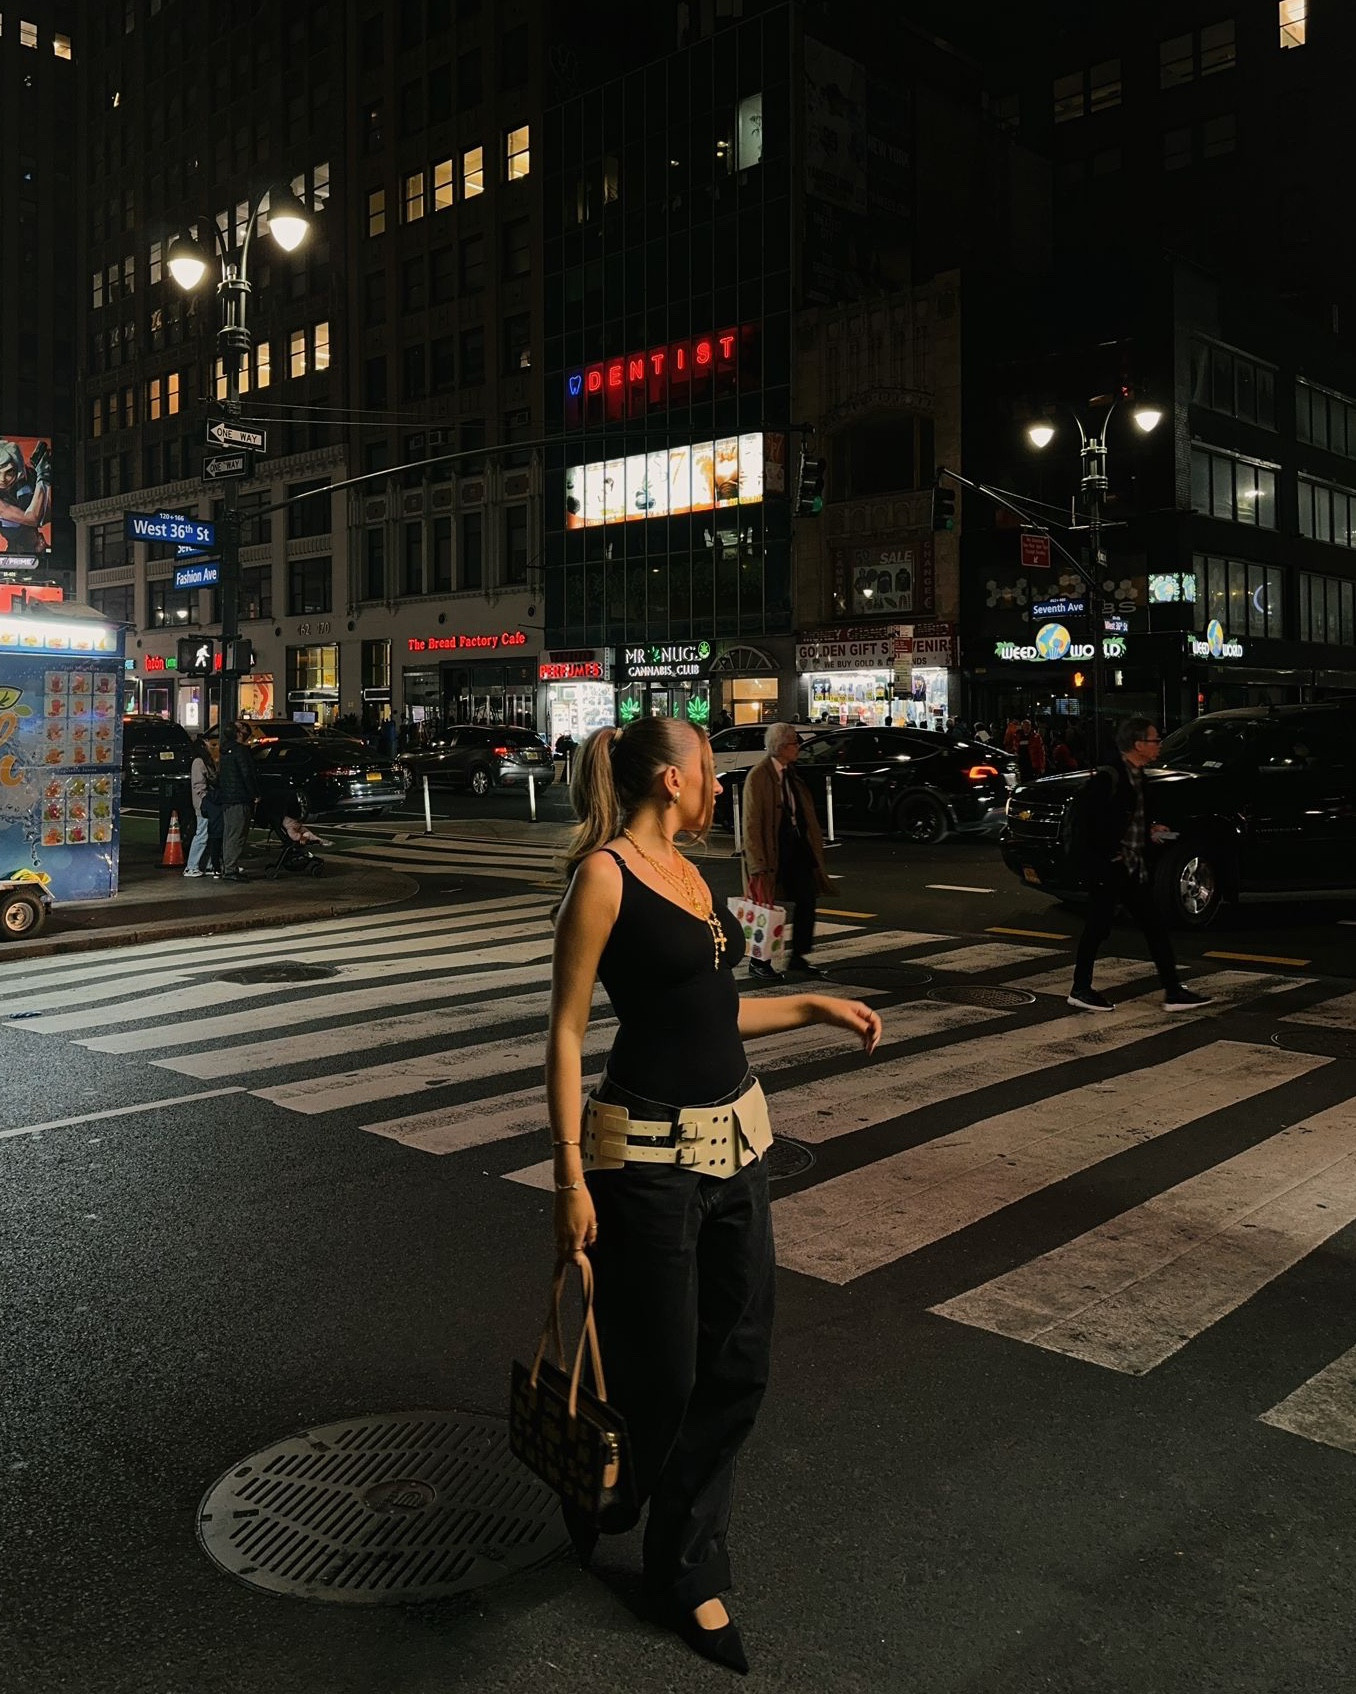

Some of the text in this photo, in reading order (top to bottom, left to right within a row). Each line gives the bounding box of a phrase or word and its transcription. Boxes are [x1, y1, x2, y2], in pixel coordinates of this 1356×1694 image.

[588, 336, 734, 391] DENTIST
[217, 427, 257, 444] ONE WAY
[210, 460, 240, 472] ONE WAY
[133, 520, 210, 541] West 36th St
[880, 550, 912, 565] SALE
[176, 567, 217, 586] Fashion Ave
[1033, 602, 1084, 614] Seventh Ave
[408, 631, 525, 650] The Bread Factory Cafe
[850, 643, 877, 656] GIFT
[881, 639, 952, 655] SENIR
[1192, 641, 1243, 657] WEED WORLD
[625, 648, 646, 664] MR
[1001, 643, 1121, 660] WEED WOLD
[539, 662, 602, 679] PERFUMES
[628, 664, 700, 677] CANNABIS CLUB
[824, 660, 834, 668] WE
[837, 660, 851, 668] BUY
[855, 659, 874, 667] GOLD
[887, 657, 927, 666] DNDS
